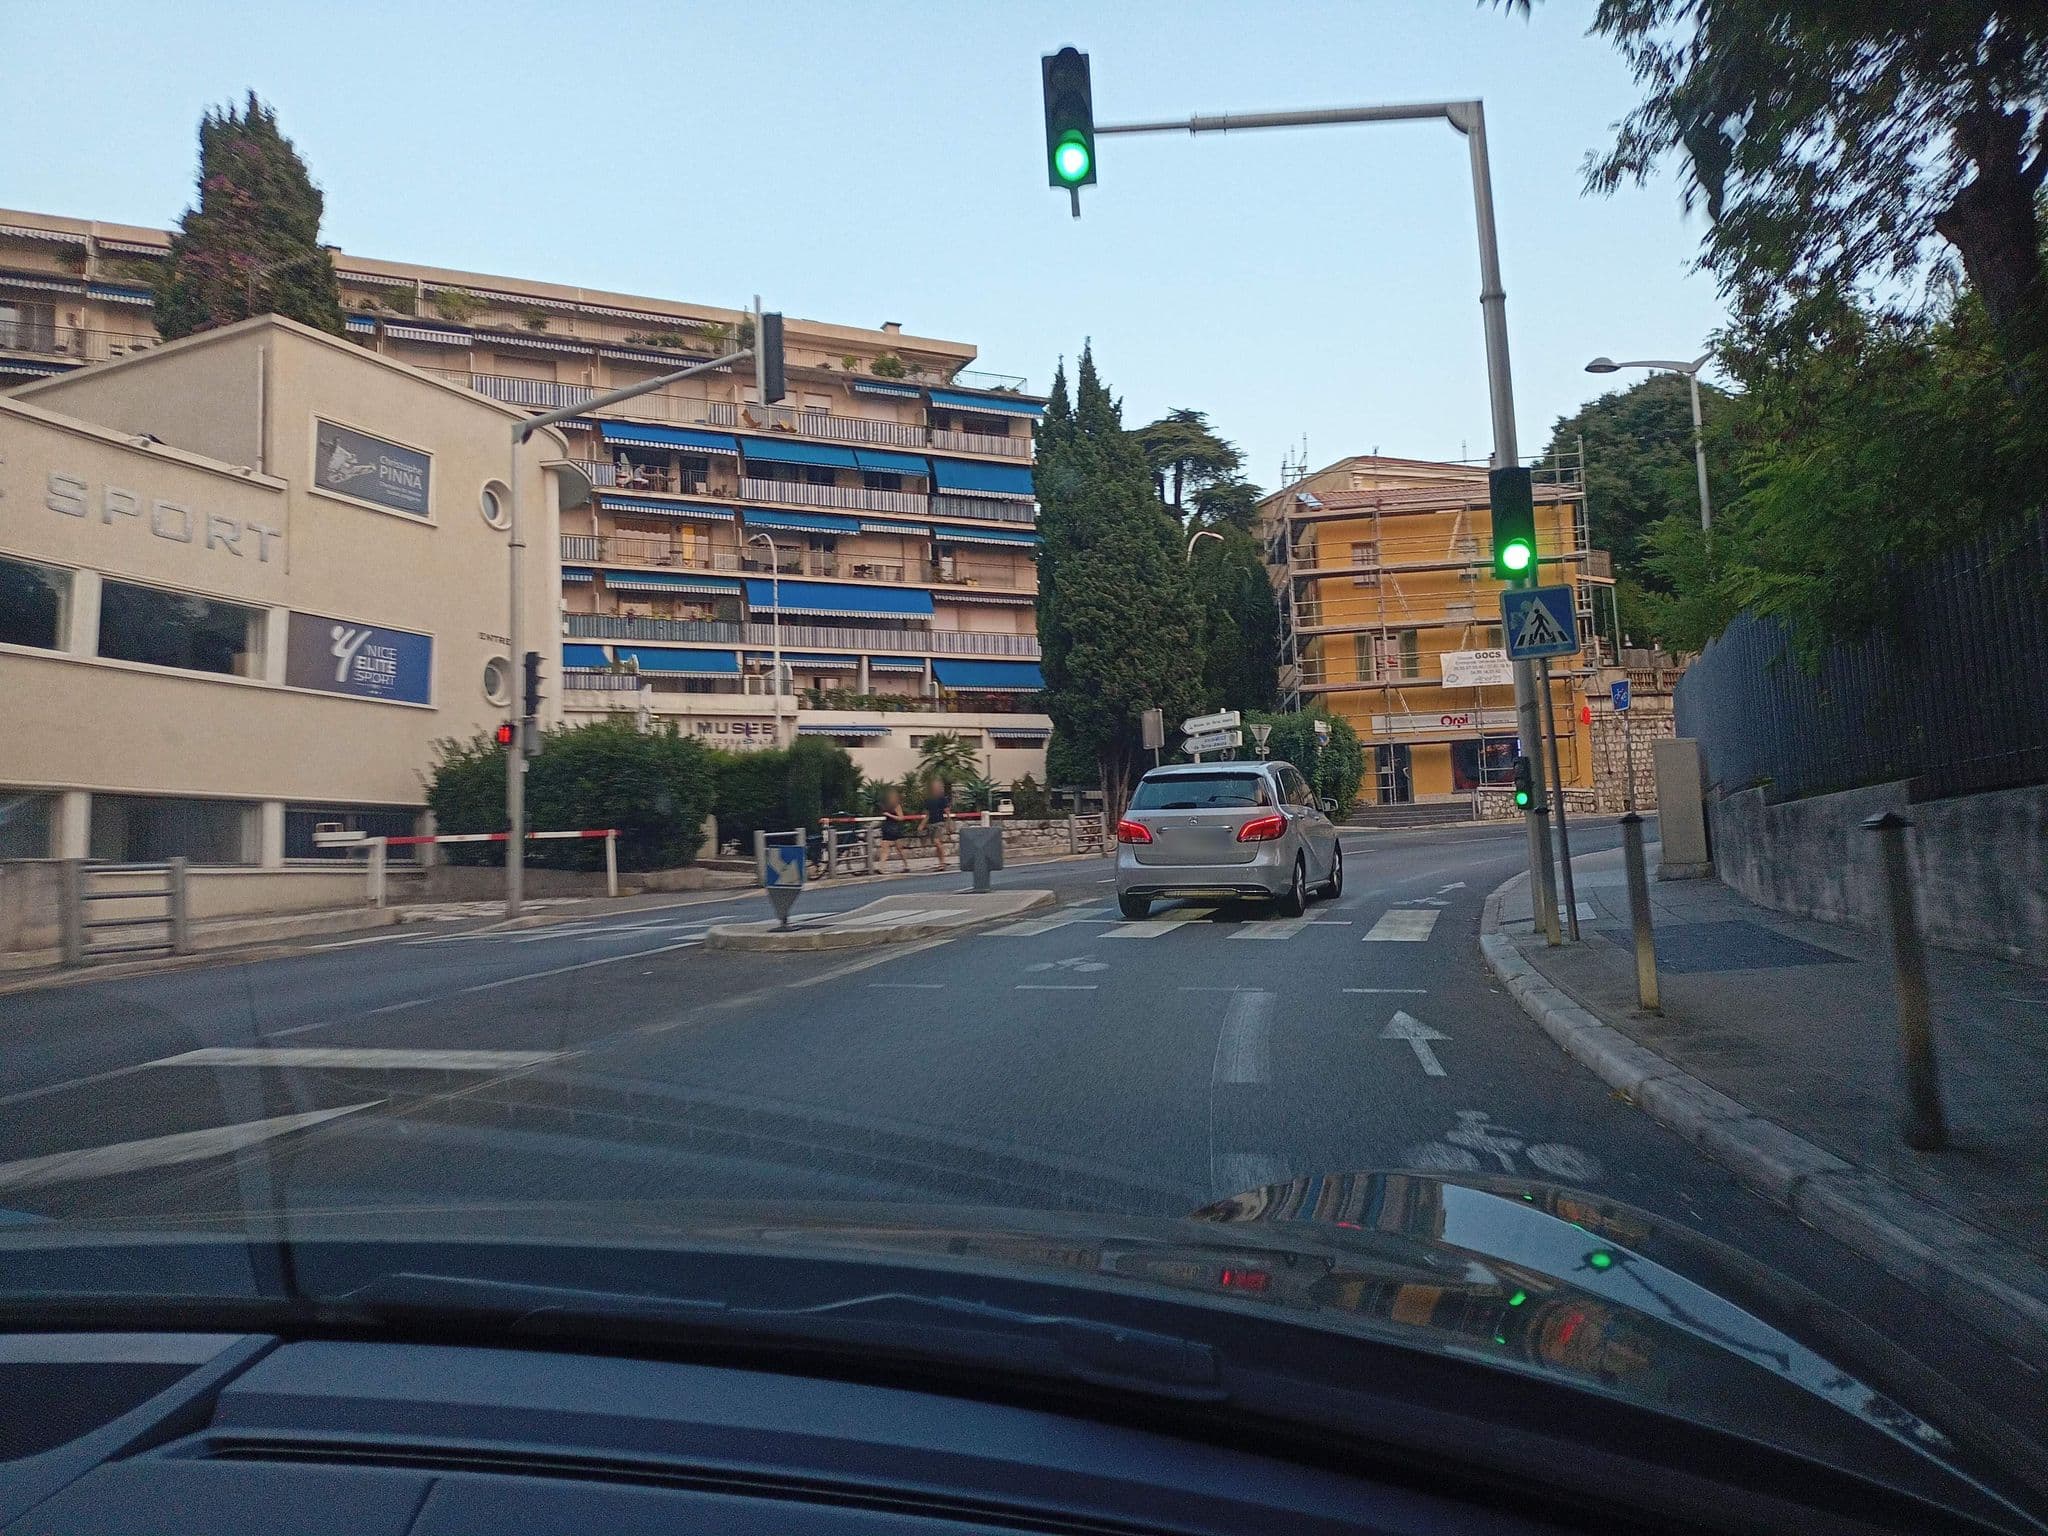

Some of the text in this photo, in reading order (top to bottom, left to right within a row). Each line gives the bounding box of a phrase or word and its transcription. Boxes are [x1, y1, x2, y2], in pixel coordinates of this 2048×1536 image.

[380, 465, 422, 489] PINNA
[47, 471, 281, 562] SPORT
[366, 645, 397, 660] NICE
[355, 656, 397, 674] ELITE
[354, 670, 396, 685] SPORT
[697, 722, 774, 734] MUSEE
[1441, 714, 1468, 728] Orpi
